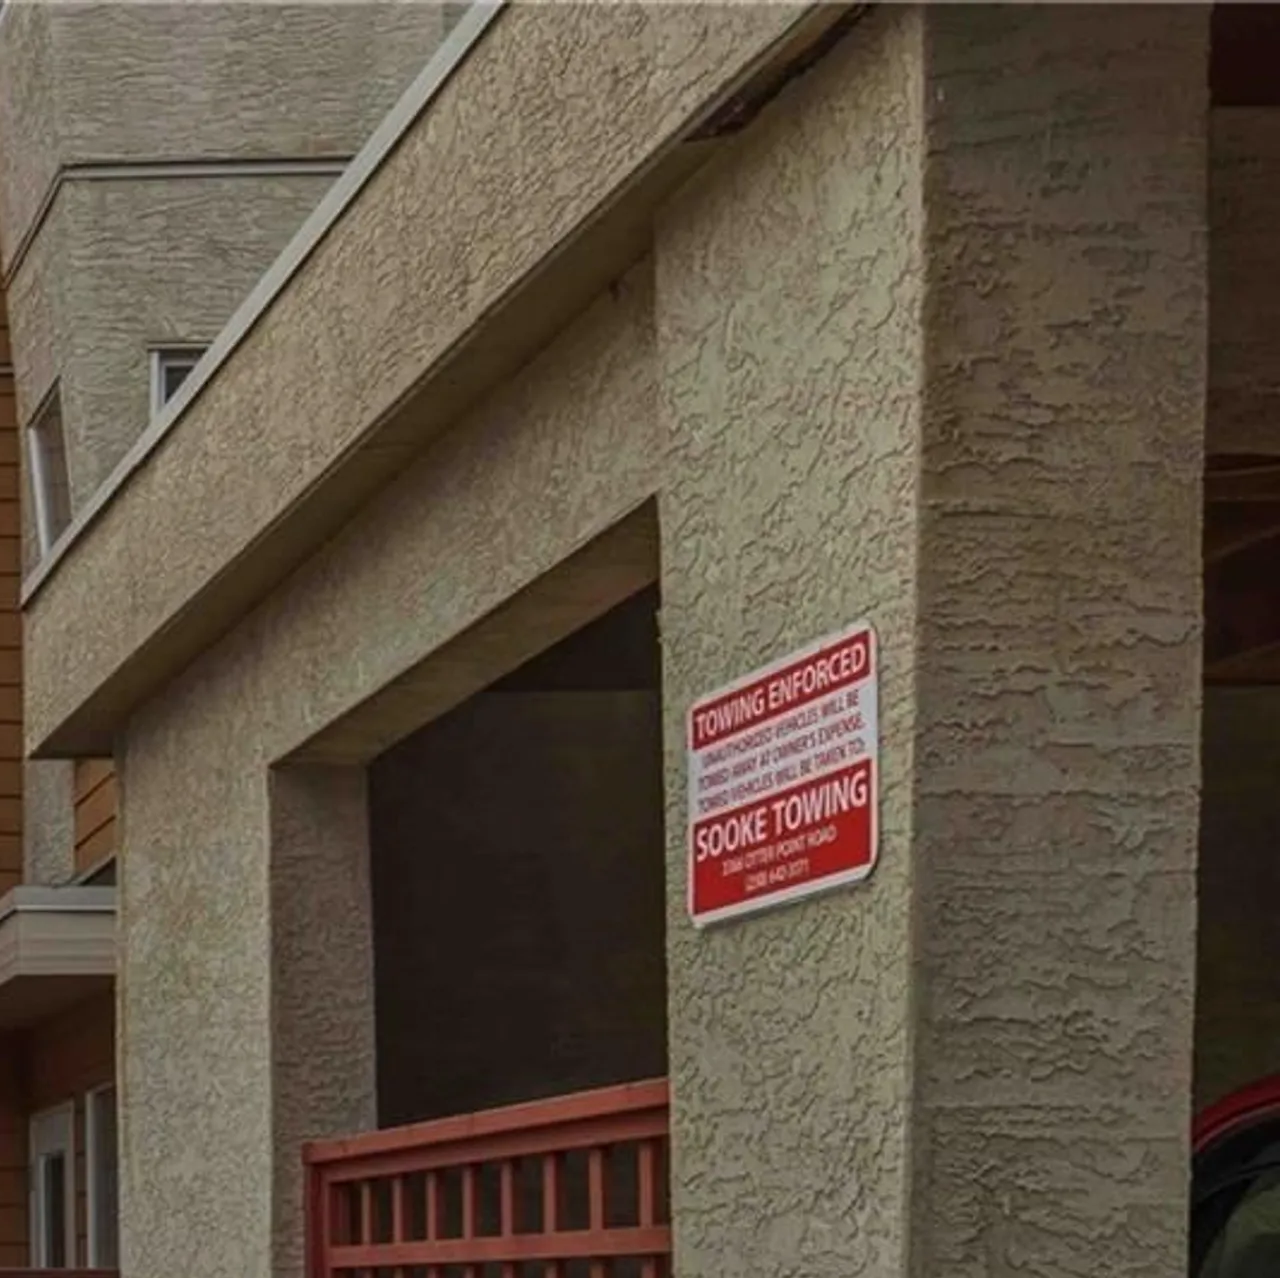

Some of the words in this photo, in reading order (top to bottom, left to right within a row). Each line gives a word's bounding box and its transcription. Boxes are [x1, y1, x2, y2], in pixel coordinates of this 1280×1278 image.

[695, 689, 764, 741] TOWING
[769, 643, 867, 711] ENFORCED
[696, 803, 768, 863] SOOKE
[771, 770, 868, 832] TOWING
